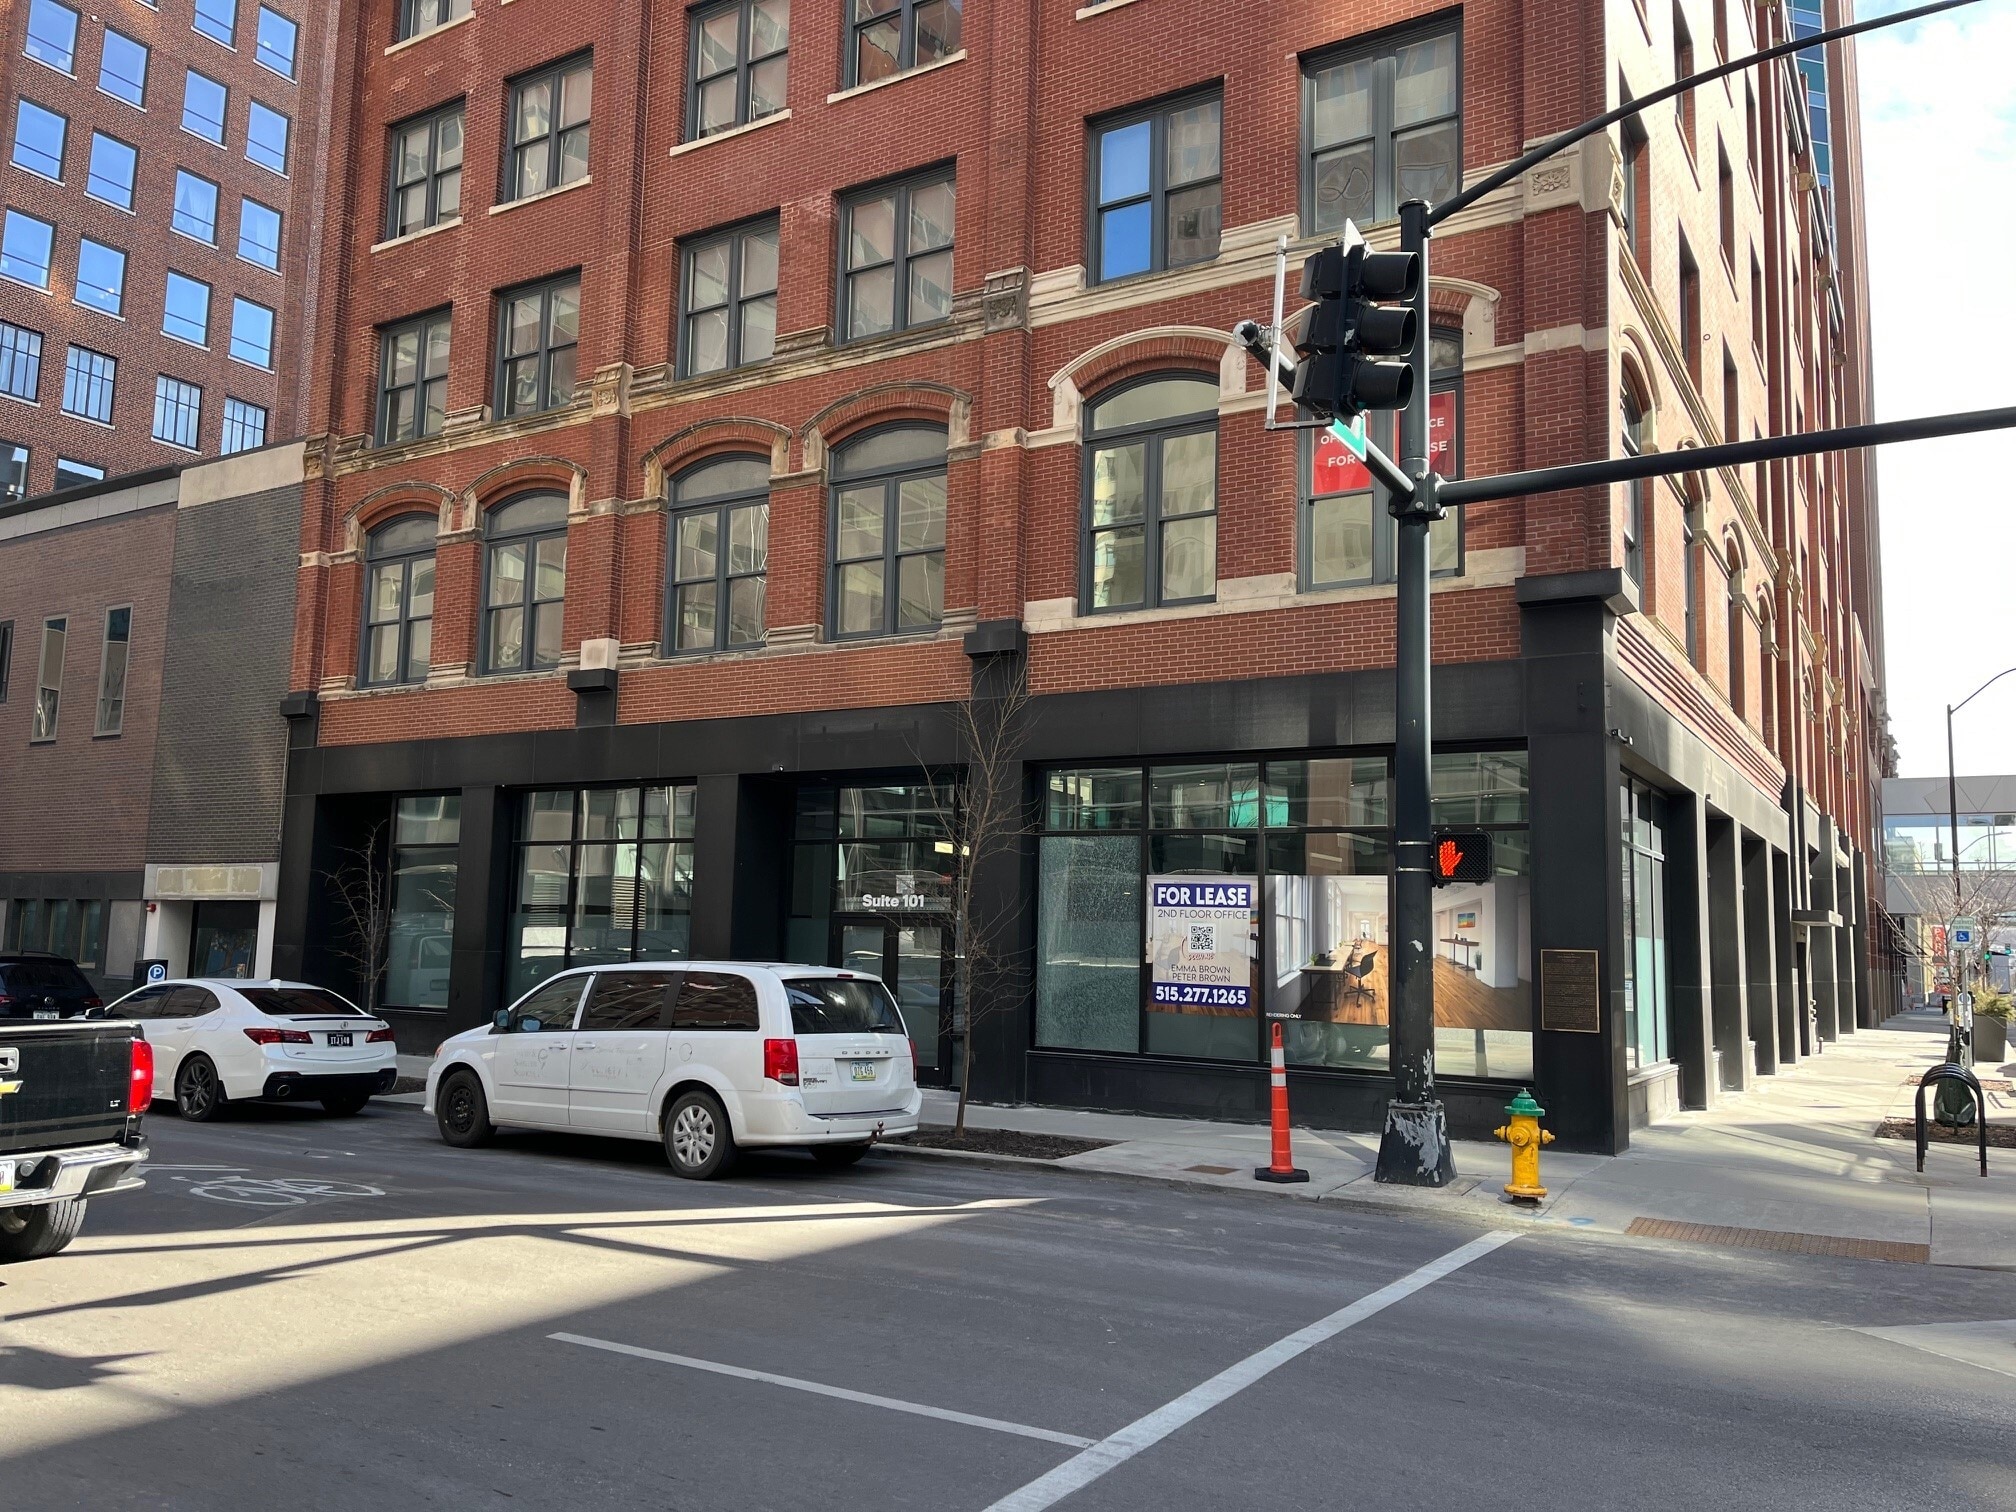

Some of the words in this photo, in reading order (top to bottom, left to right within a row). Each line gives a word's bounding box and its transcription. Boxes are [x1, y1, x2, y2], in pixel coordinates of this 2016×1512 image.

[1327, 454, 1356, 468] FOR
[862, 893, 900, 907] Suite
[902, 894, 924, 908] 101
[1157, 886, 1191, 905] FOR
[1196, 887, 1247, 906] LEASE
[1157, 909, 1178, 919] 2ND
[1180, 909, 1212, 919] FLOOR
[1214, 910, 1248, 920] OFFICE
[153, 967, 162, 977] P
[1171, 964, 1197, 973] EMMA
[1199, 964, 1231, 974] BROWN
[1172, 972, 1197, 981] PETER
[1199, 973, 1231, 982] BROWN
[1155, 986, 1247, 1005] 515.277.1265
